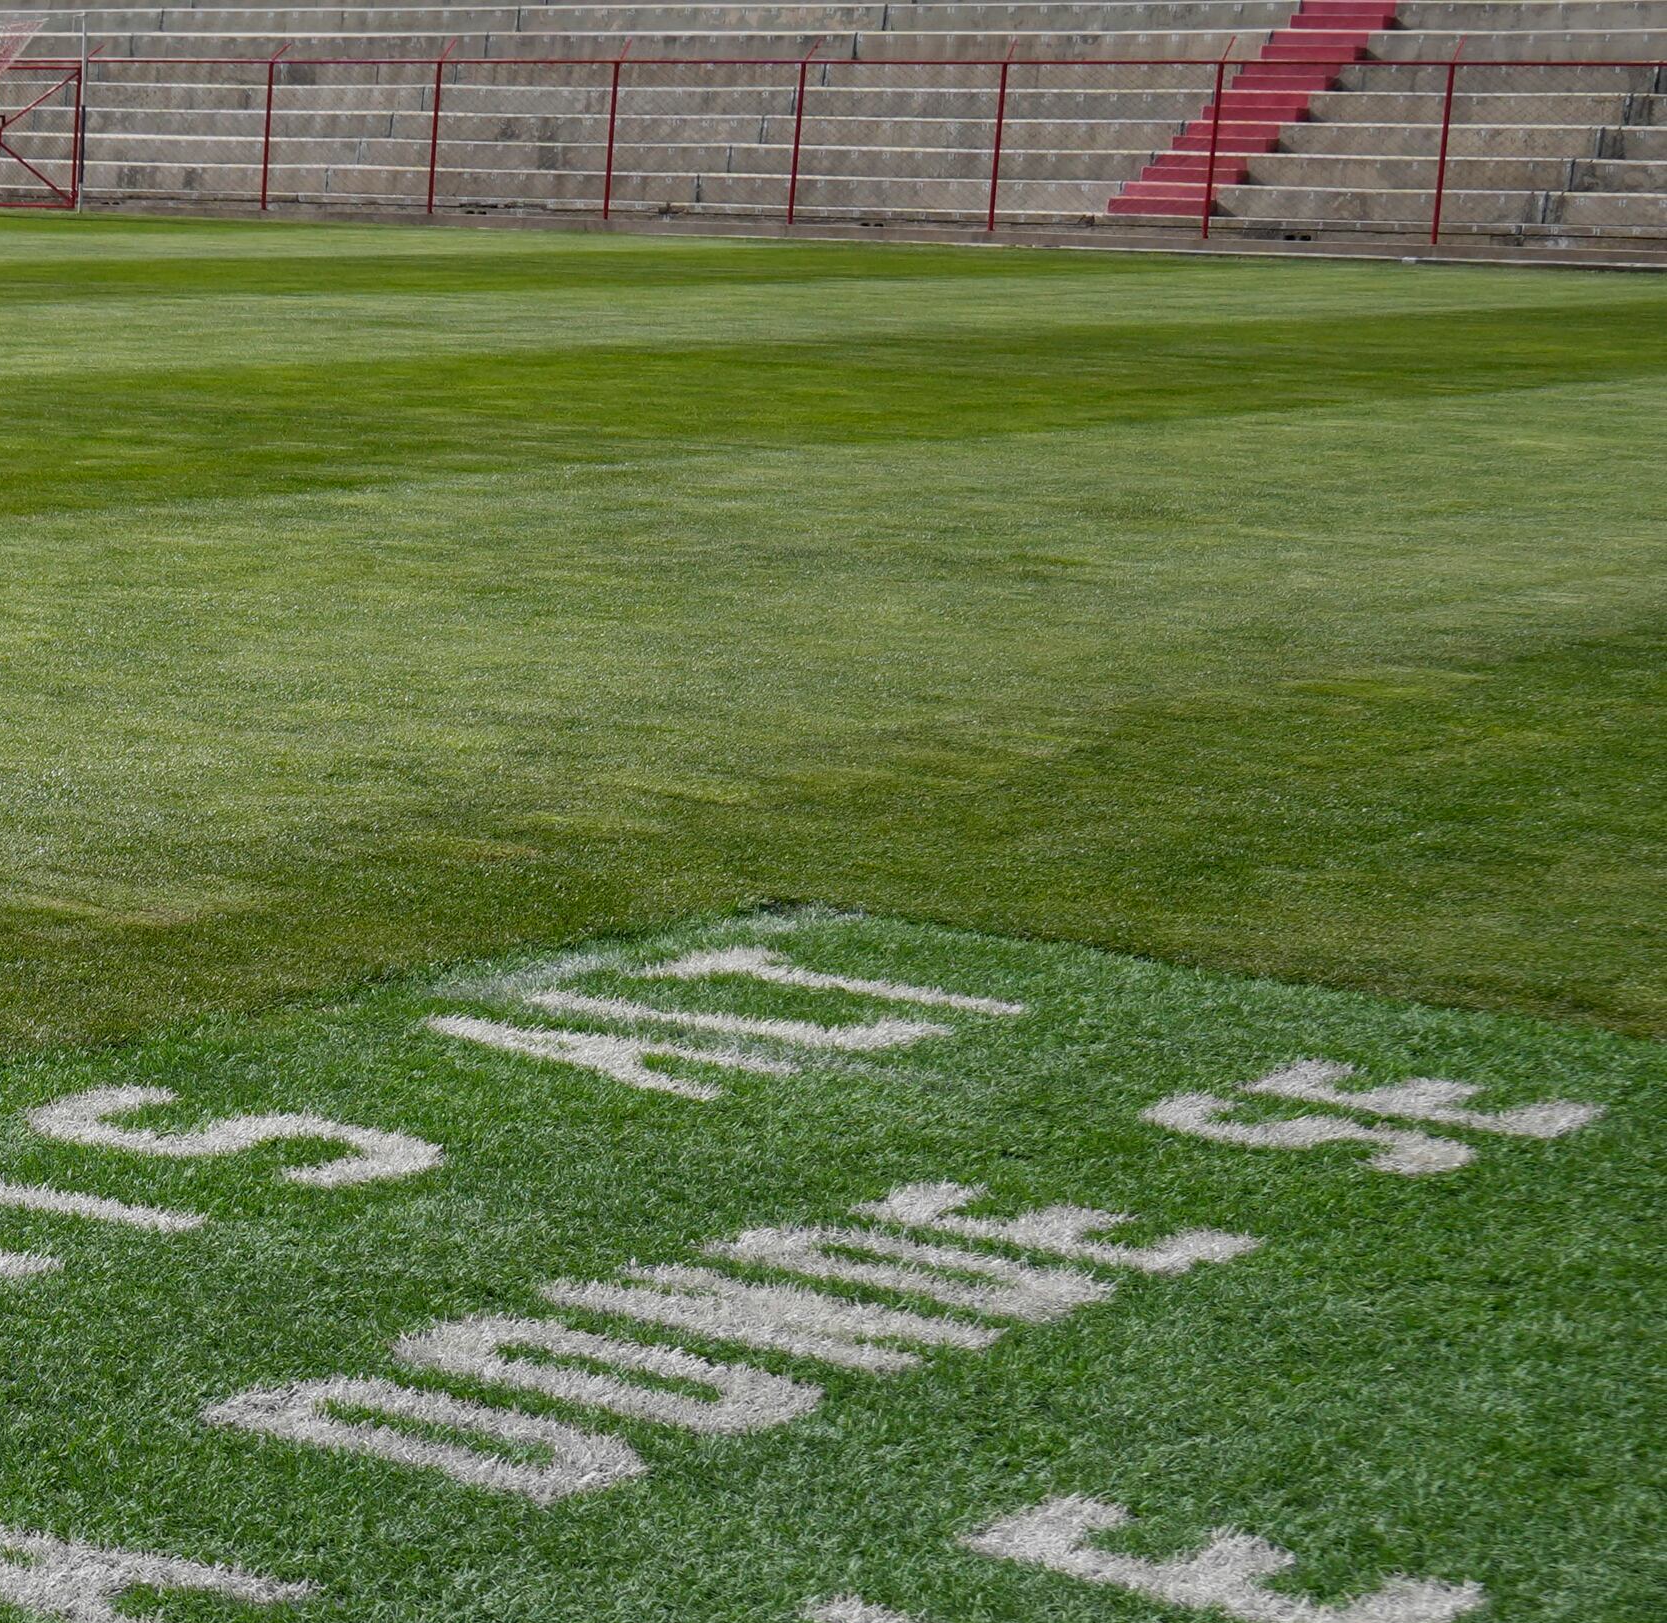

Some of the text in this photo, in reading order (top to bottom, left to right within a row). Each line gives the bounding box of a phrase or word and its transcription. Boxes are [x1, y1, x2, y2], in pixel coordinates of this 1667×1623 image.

[427, 945, 1027, 1100] ALT
[199, 1180, 1262, 1506] DONDE
[1140, 1057, 1606, 1176] SE
